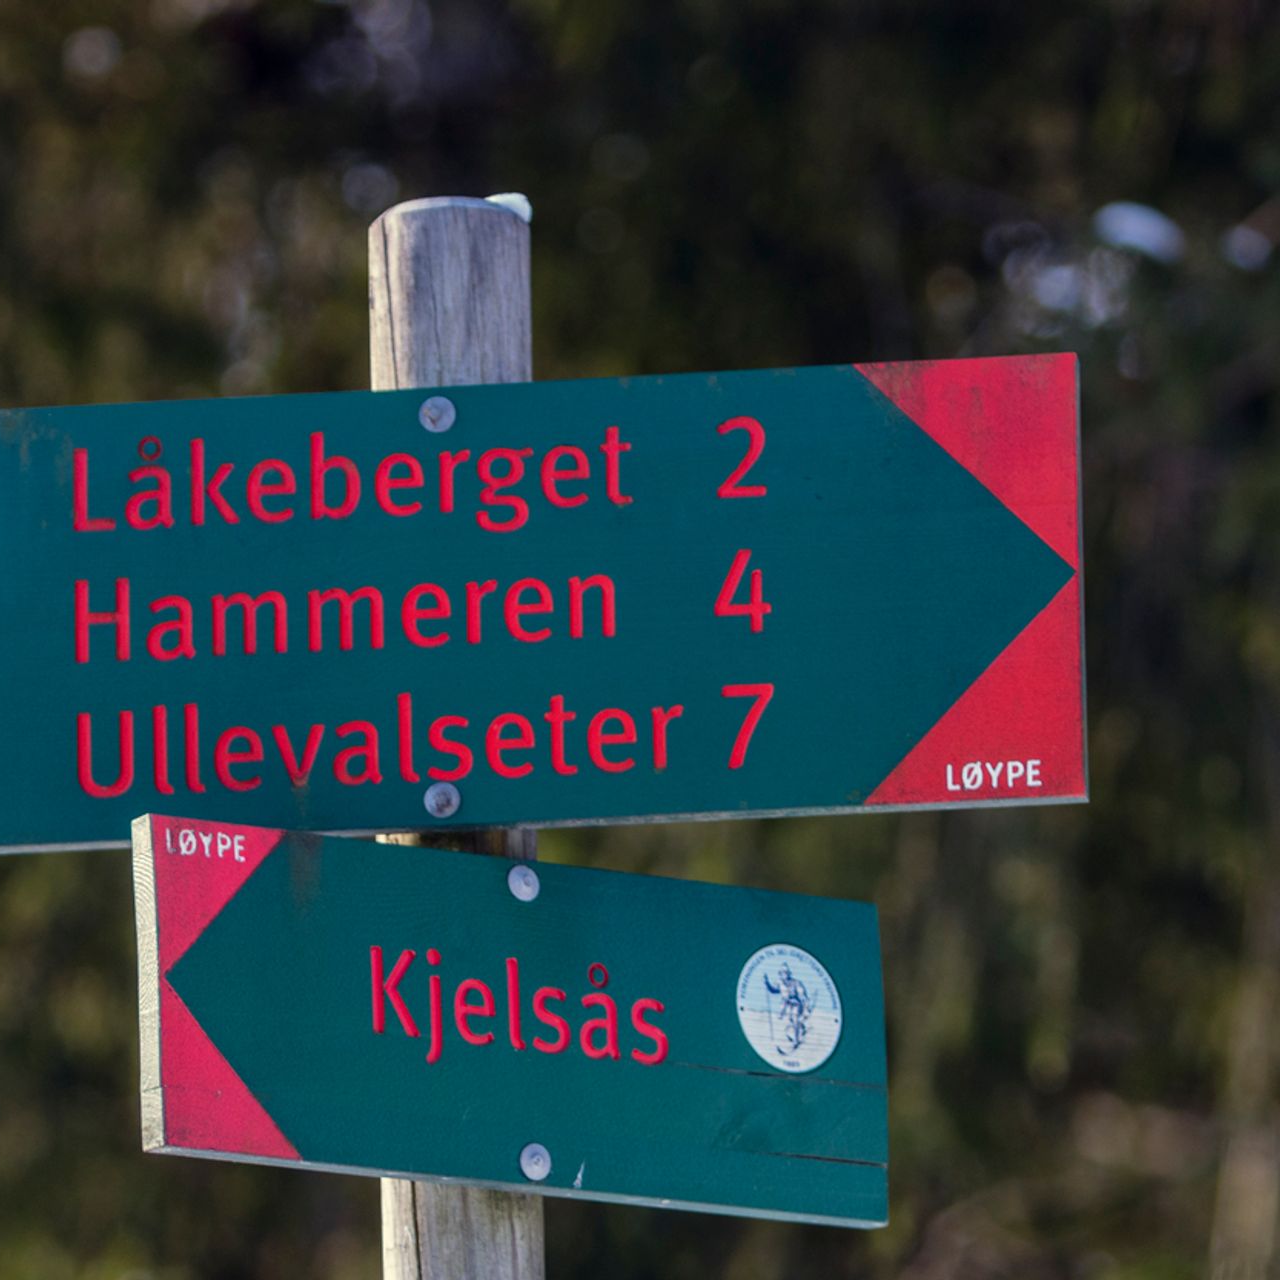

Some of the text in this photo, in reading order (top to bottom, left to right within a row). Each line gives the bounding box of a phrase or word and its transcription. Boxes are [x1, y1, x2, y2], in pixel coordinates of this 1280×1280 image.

[72, 424, 633, 534] Låkeberget
[716, 415, 768, 500] 2
[74, 548, 773, 664] Hammeren 4
[76, 682, 776, 799] Ullevalseter 7
[946, 759, 1043, 791] LØYPE
[165, 827, 247, 863] LØYPE
[369, 944, 670, 1066] Kjelsås
